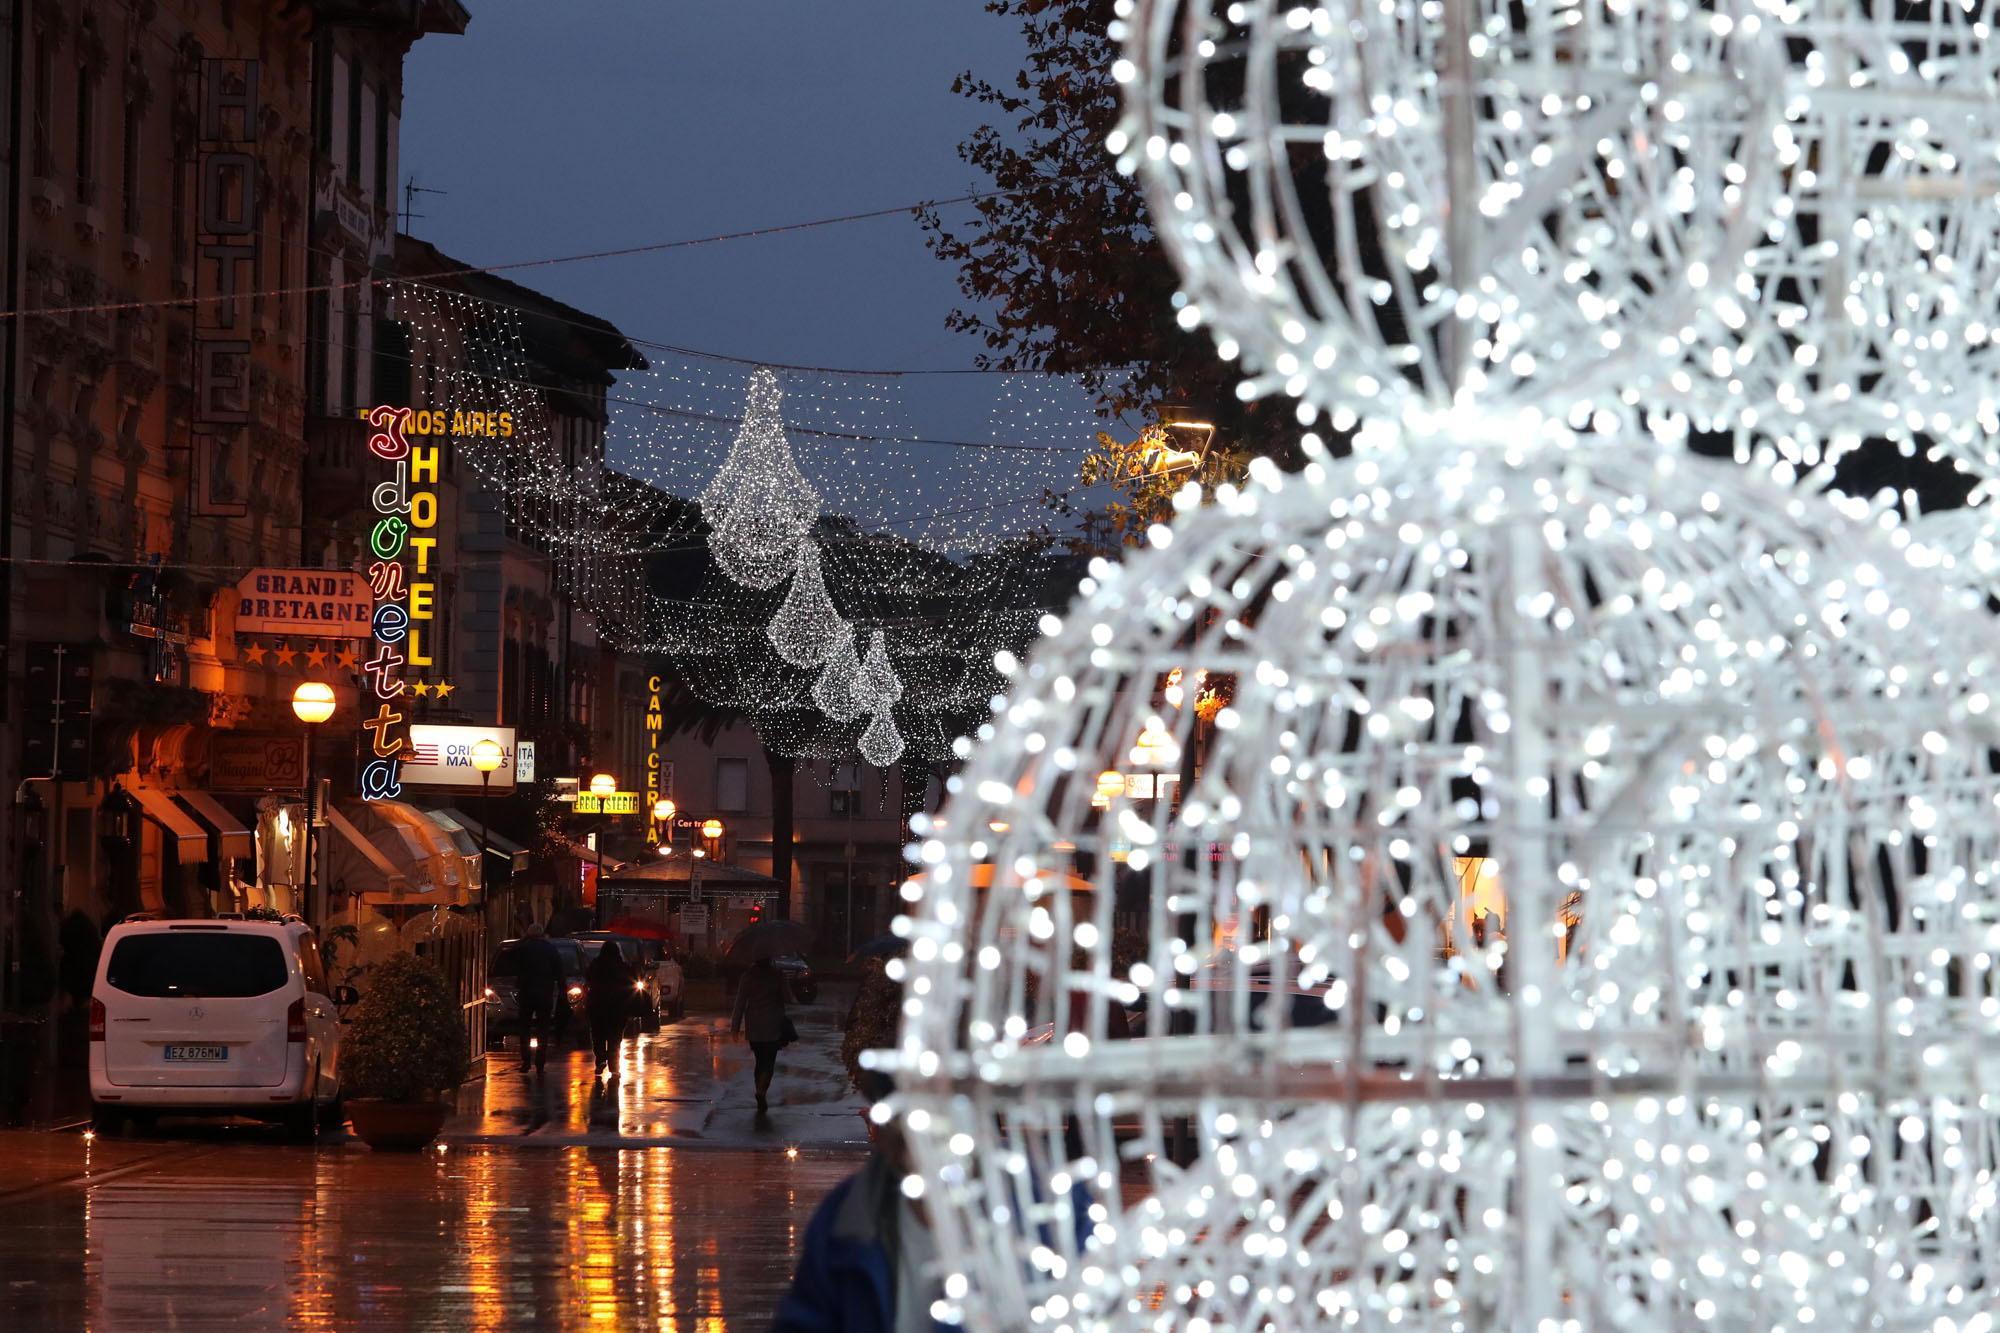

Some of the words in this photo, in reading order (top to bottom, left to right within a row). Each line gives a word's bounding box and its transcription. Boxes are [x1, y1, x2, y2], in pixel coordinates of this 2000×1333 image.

[194, 59, 259, 517] HOTEL
[452, 411, 513, 437] AIRES
[408, 447, 439, 666] HOTEL
[256, 574, 354, 597] GRANDE
[239, 599, 369, 622] BRETAGNE
[446, 744, 513, 757] ORIL
[646, 676, 662, 844] CAMICERIA
[574, 796, 639, 811] ERBORSTERIA
[172, 1047, 185, 1058] EZ
